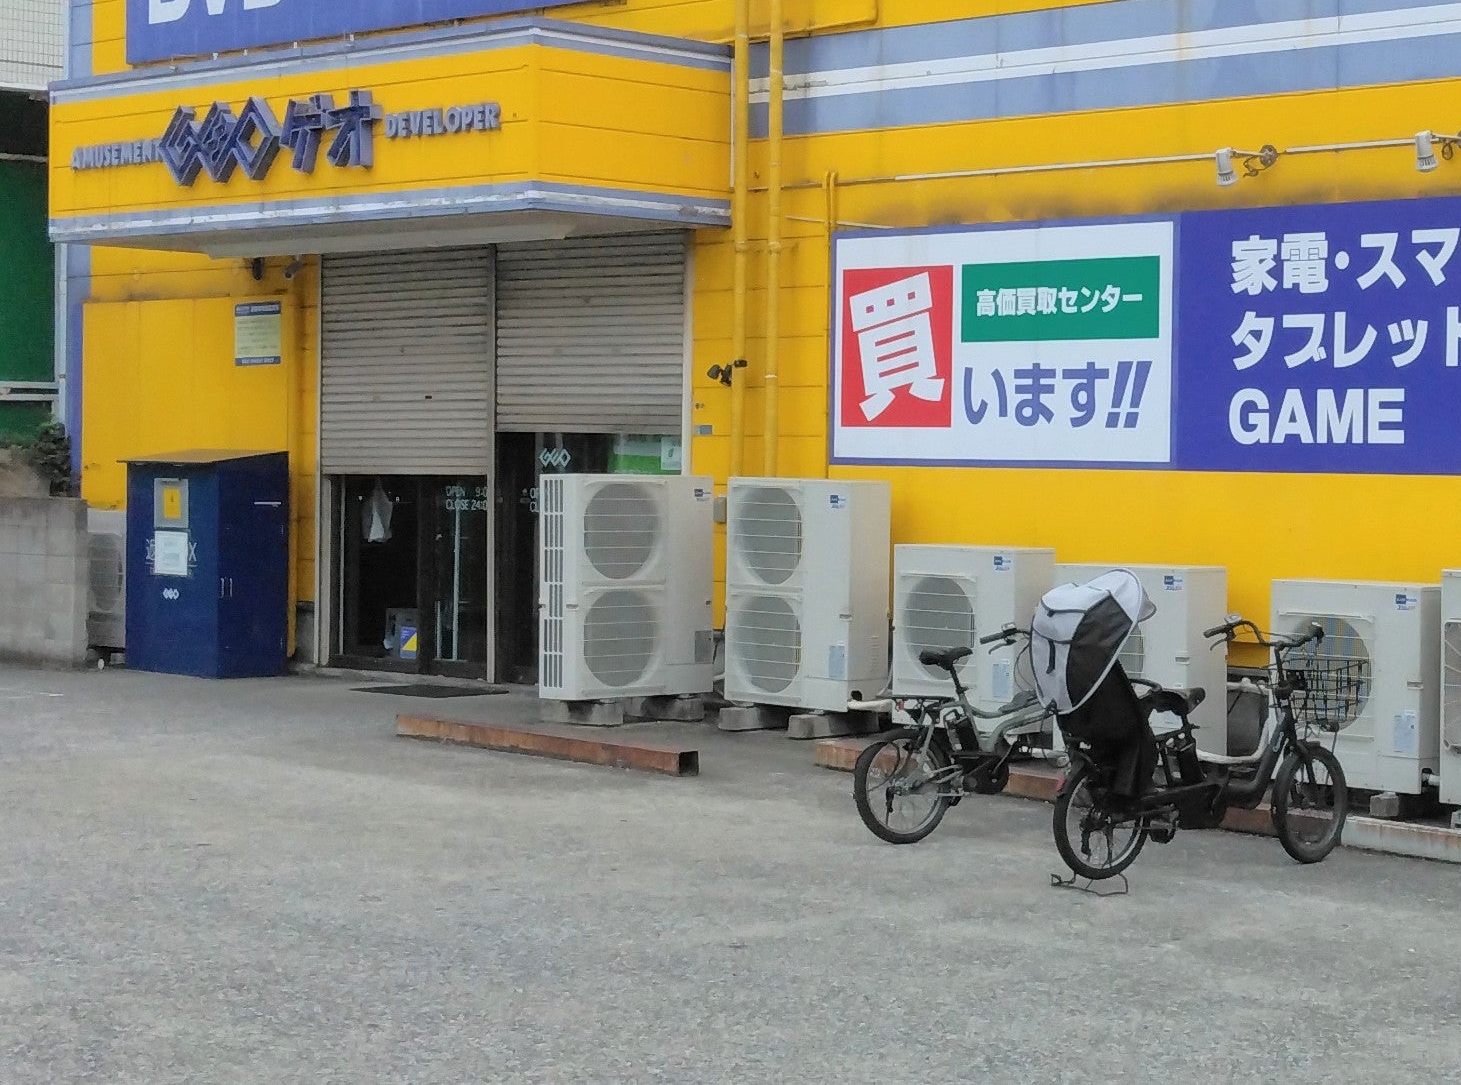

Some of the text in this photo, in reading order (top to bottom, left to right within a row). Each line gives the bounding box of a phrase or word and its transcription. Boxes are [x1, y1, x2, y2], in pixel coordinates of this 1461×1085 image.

[71, 139, 164, 171] AMUSEMENT
[280, 89, 383, 174] ゲオ
[385, 103, 501, 141] DEVELOPER
[976, 282, 1144, 318] 高価買取センター
[849, 271, 946, 422] 買
[1228, 387, 1405, 444] GAME
